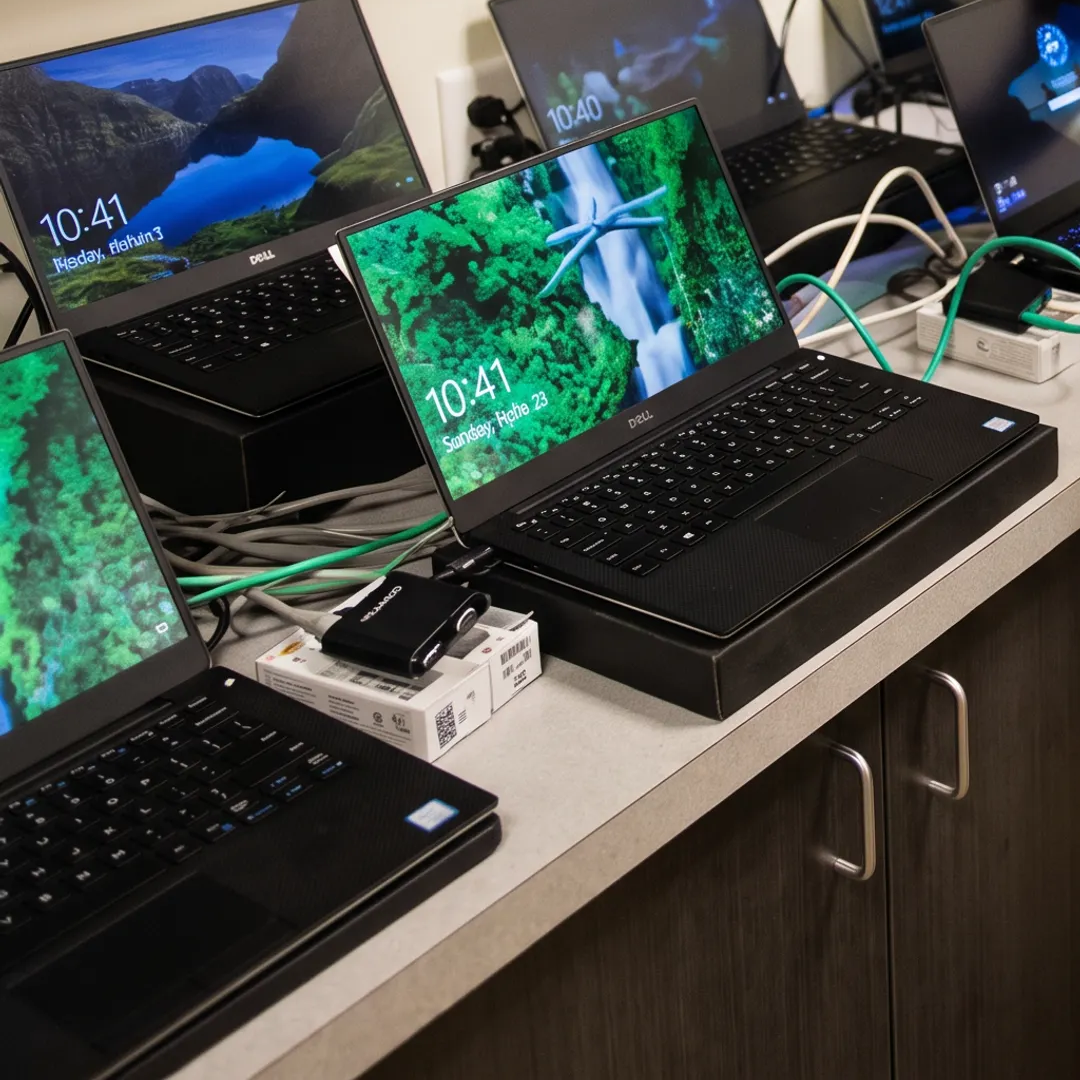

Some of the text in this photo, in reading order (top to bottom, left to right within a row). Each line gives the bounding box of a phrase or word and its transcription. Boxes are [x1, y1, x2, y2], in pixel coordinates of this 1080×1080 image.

[547, 94, 602, 133] 10:40
[40, 193, 128, 247] 10:41
[425, 358, 511, 423] 10:41
[531, 391, 548, 410] 23
